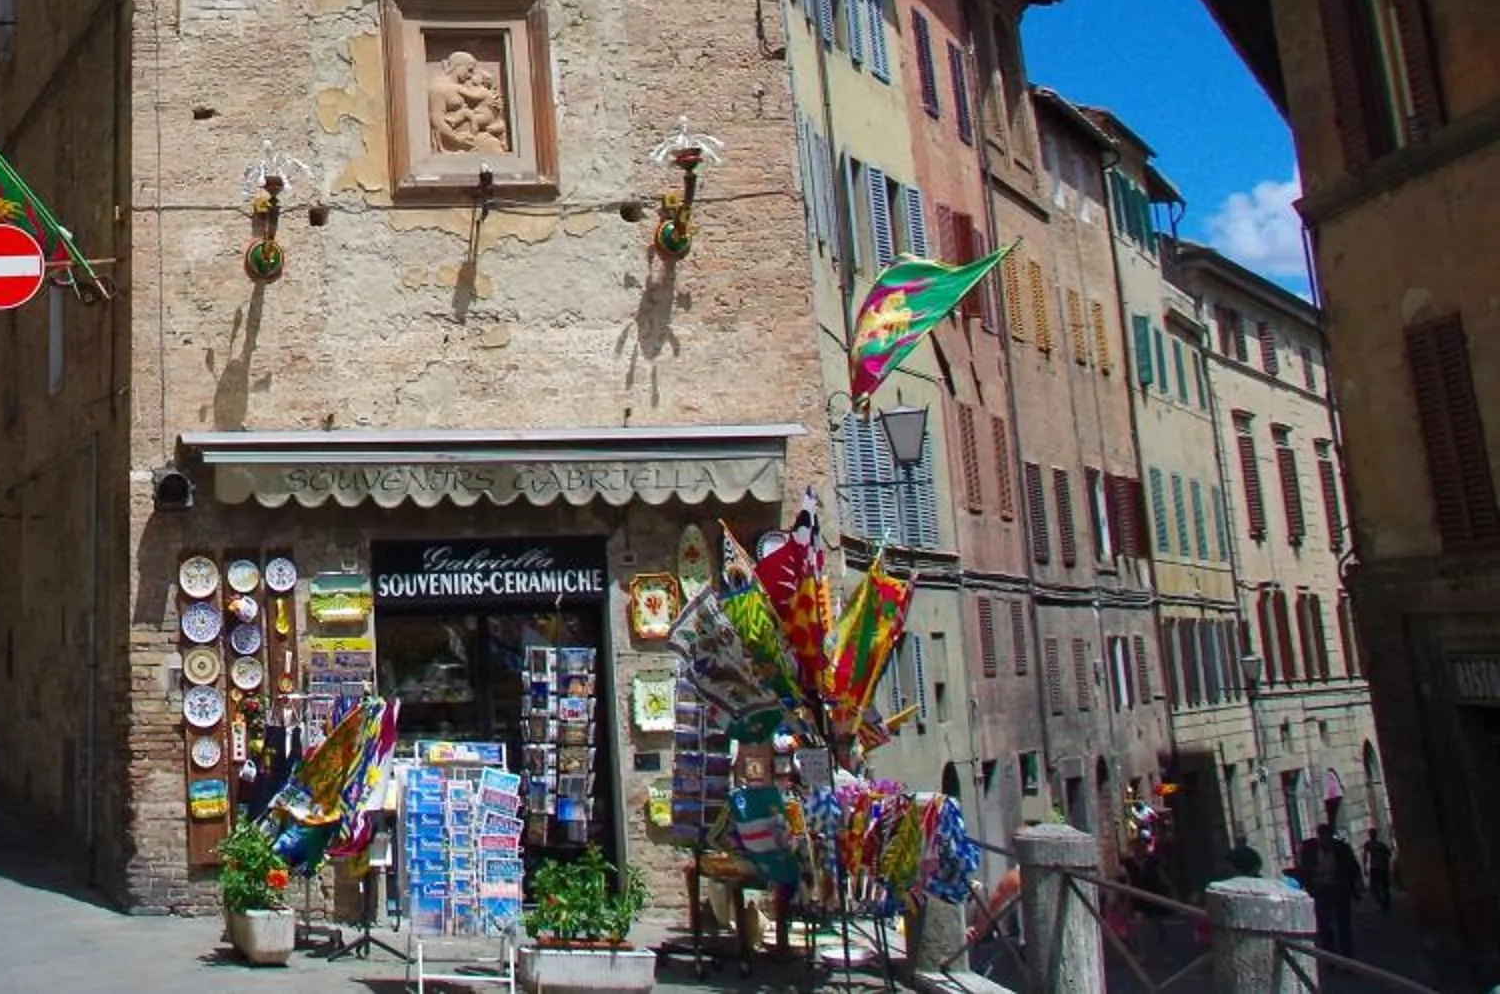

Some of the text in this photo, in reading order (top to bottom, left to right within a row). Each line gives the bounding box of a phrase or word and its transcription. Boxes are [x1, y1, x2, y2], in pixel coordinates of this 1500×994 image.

[287, 467, 495, 493] SOUVENIRS
[422, 546, 555, 573] Gabriella
[377, 568, 604, 598] SOUVENIRS-CERAMICHE
